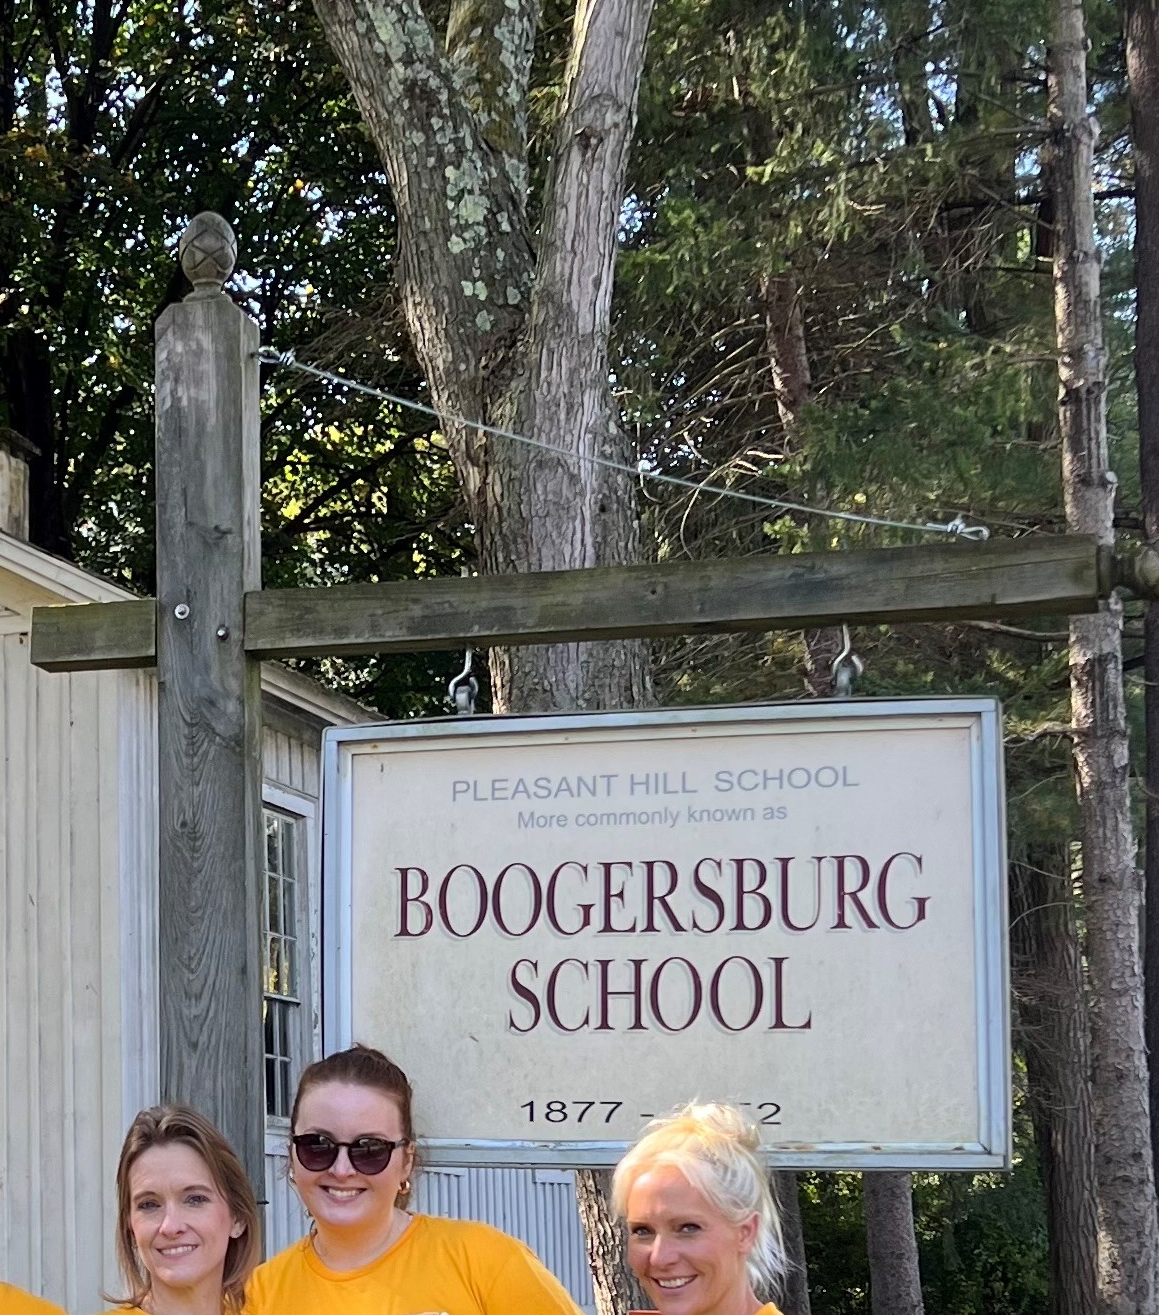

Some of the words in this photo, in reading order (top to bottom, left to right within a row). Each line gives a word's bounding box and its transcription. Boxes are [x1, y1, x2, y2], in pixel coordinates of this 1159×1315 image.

[452, 774, 619, 802] PLEASANT
[629, 771, 698, 796] HILL
[714, 765, 860, 793] SCHOOL
[517, 810, 569, 829] More
[575, 806, 680, 829] commonly
[687, 804, 755, 824] known
[762, 805, 787, 822] as
[393, 851, 932, 938] BOOGERSBURG
[508, 955, 813, 1033] SCHOOL
[520, 1100, 623, 1123] 1877
